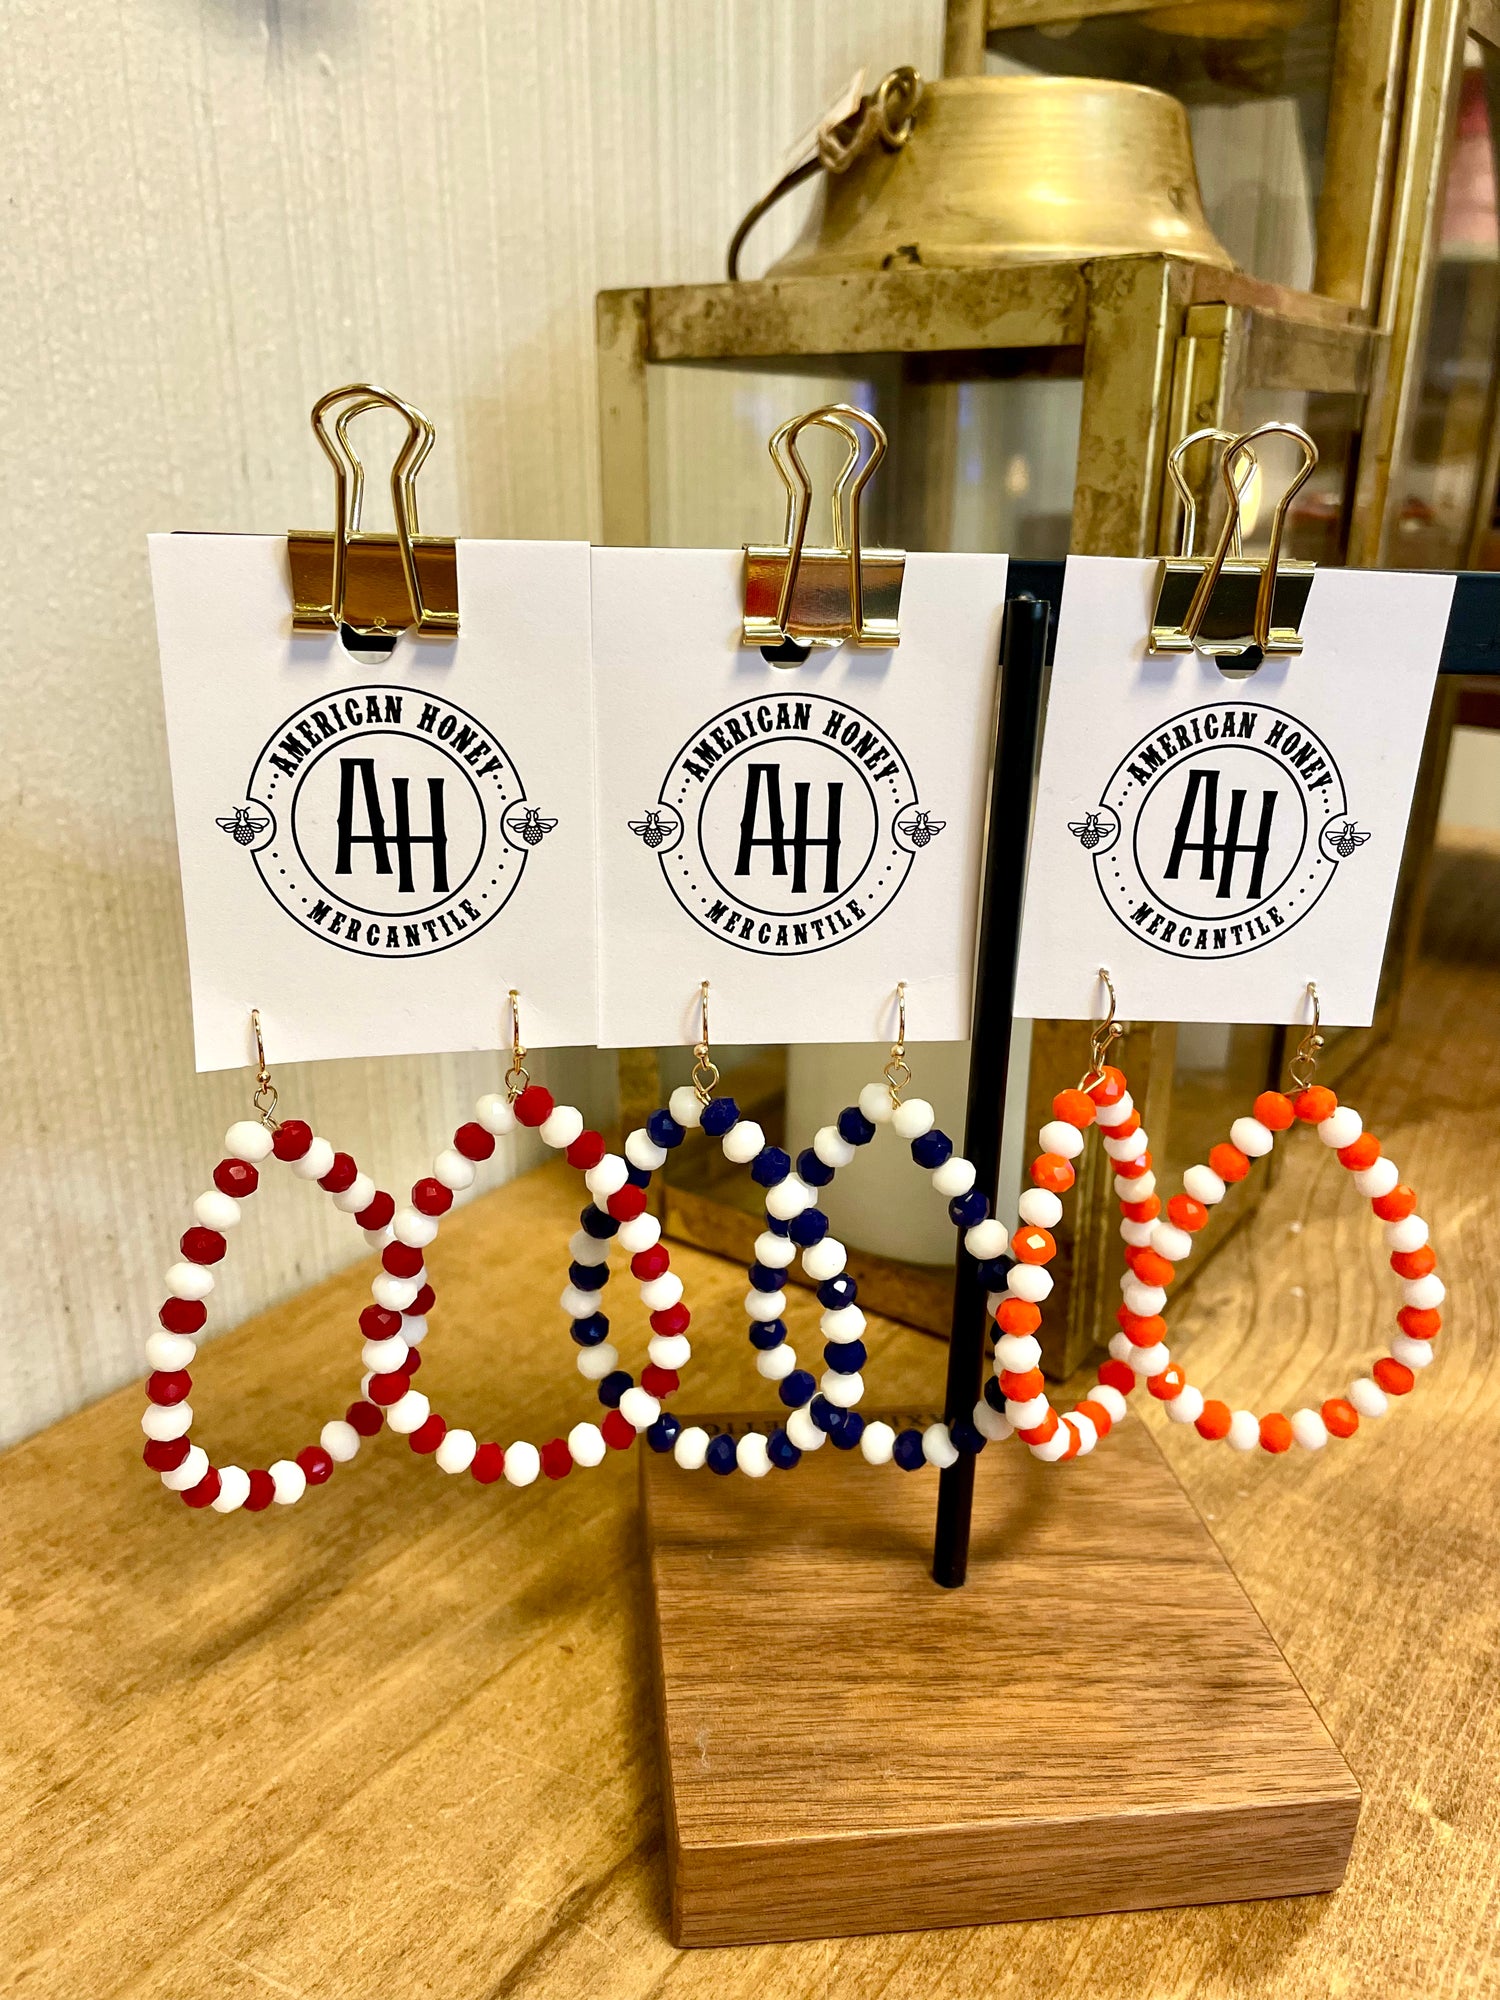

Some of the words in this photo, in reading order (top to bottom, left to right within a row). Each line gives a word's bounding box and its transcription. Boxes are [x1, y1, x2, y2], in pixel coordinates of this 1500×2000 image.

[269, 695, 402, 778] AMERICAN
[417, 703, 503, 777] HONEY
[682, 703, 811, 783] AMERICAN
[822, 710, 899, 782] HONEY
[1127, 712, 1257, 786] AMERICAN
[1264, 720, 1333, 791] HONEY
[335, 758, 449, 892] AH
[734, 764, 843, 893] AH
[1163, 770, 1278, 899] AH
[307, 899, 481, 947] MERCANTILE
[705, 899, 866, 945] MERCANTILE
[1130, 901, 1284, 949] MERCANTILE
